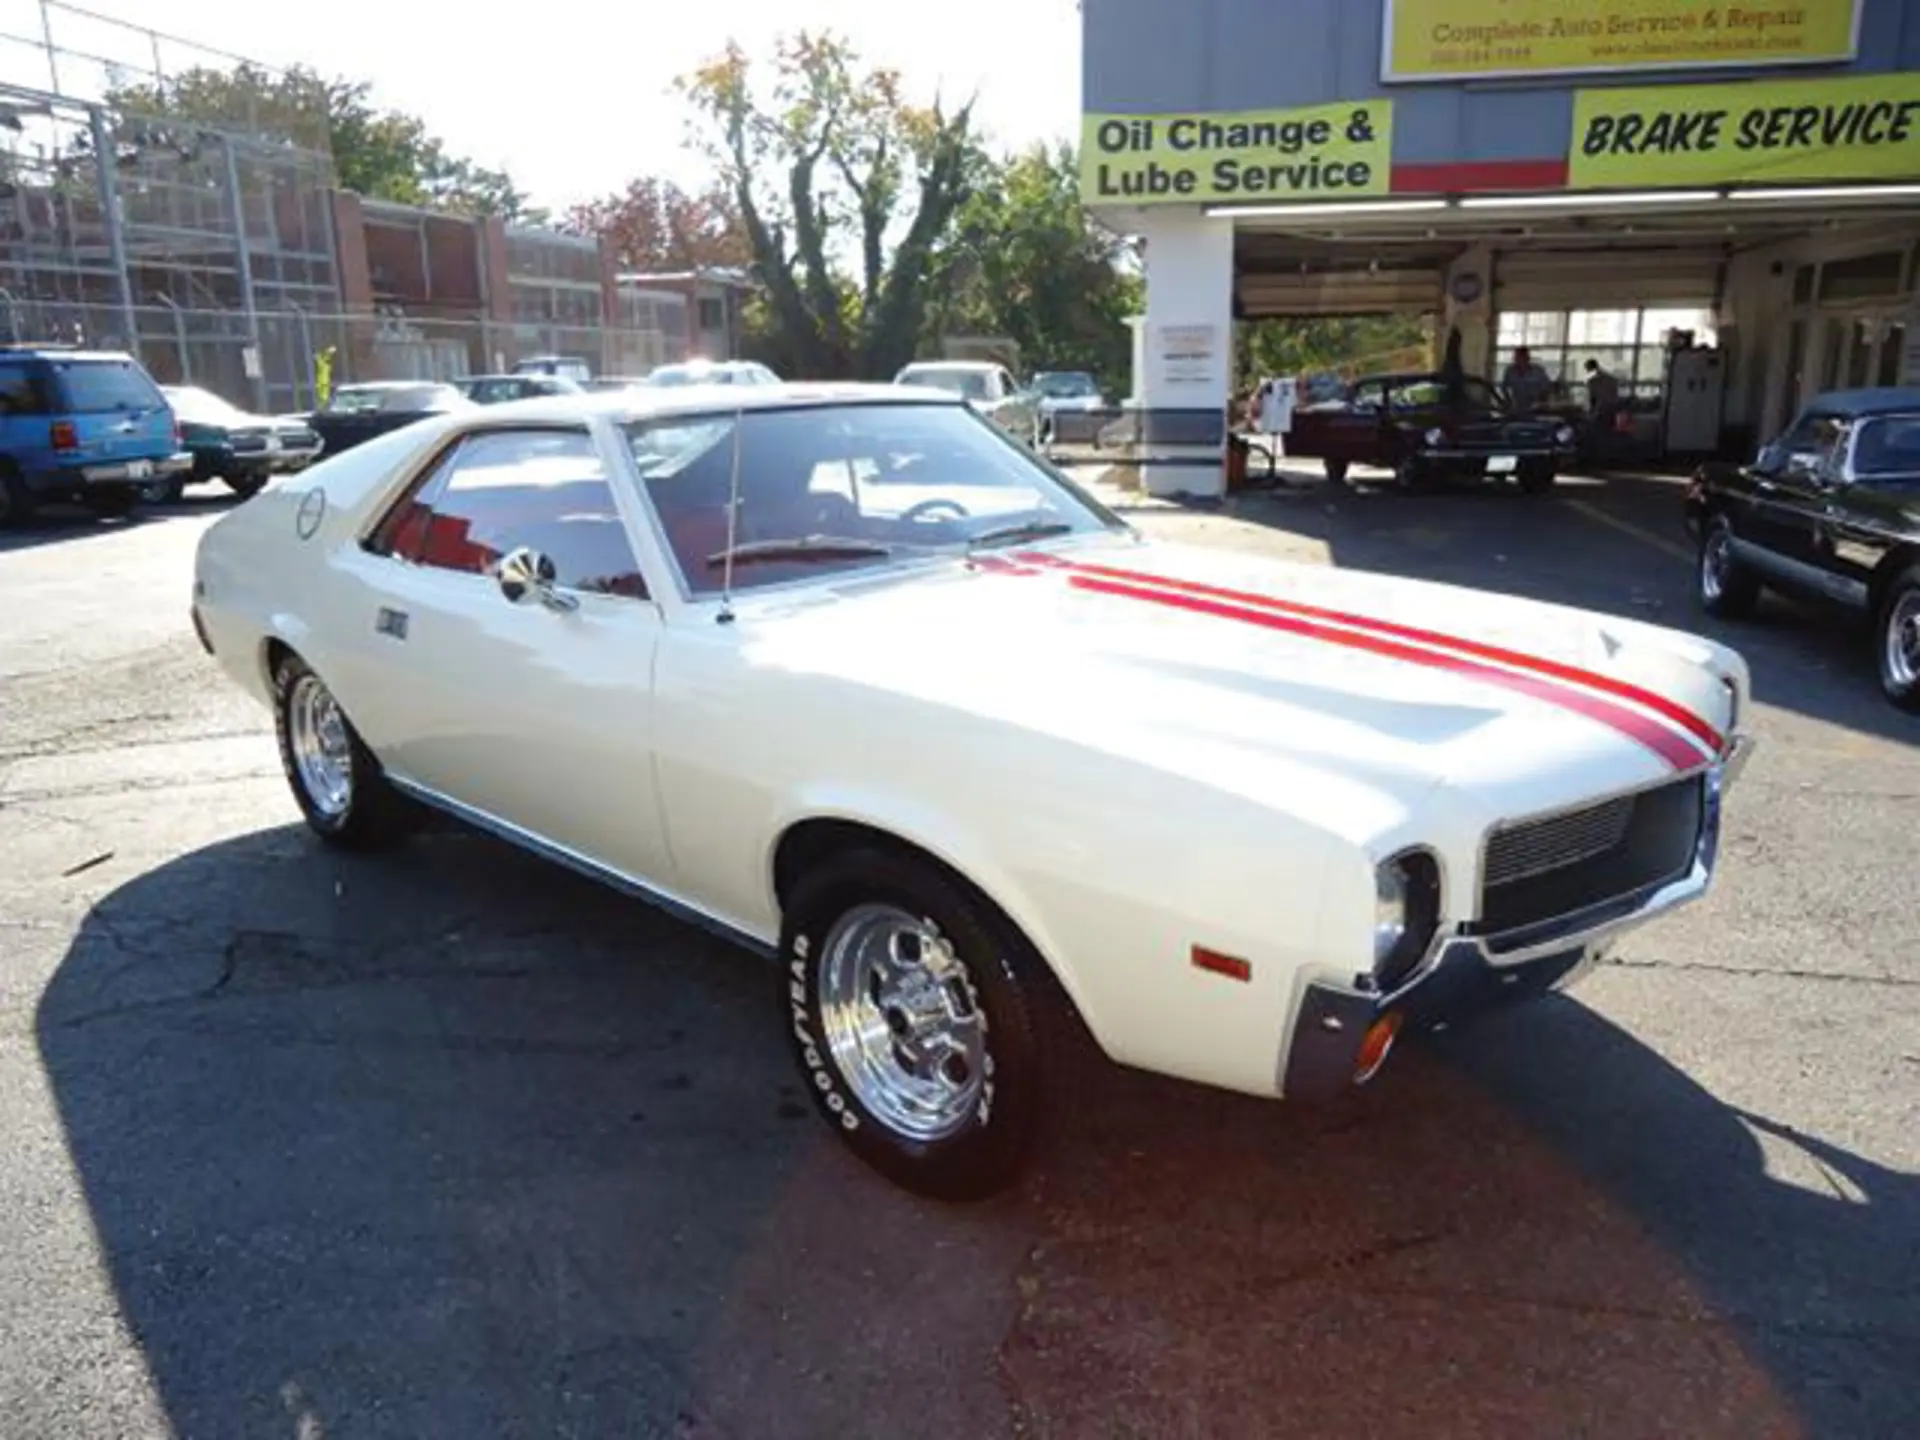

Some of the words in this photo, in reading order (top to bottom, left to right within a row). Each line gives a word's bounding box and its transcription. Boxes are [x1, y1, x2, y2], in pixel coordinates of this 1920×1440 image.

[1432, 22, 1543, 45] Complete
[1548, 16, 1603, 38] Auto
[1607, 12, 1696, 35] Service
[1703, 8, 1718, 28] &
[1727, 7, 1804, 33] Repair
[1097, 119, 1153, 153] Oil
[1167, 117, 1330, 154] Change
[1346, 109, 1375, 143] &
[1583, 110, 1728, 157] BRAKE
[1734, 101, 1920, 150] SERVICE
[1098, 162, 1197, 196] Lube
[1211, 155, 1371, 193] Service
[790, 934, 860, 1130] GOODYEAR
